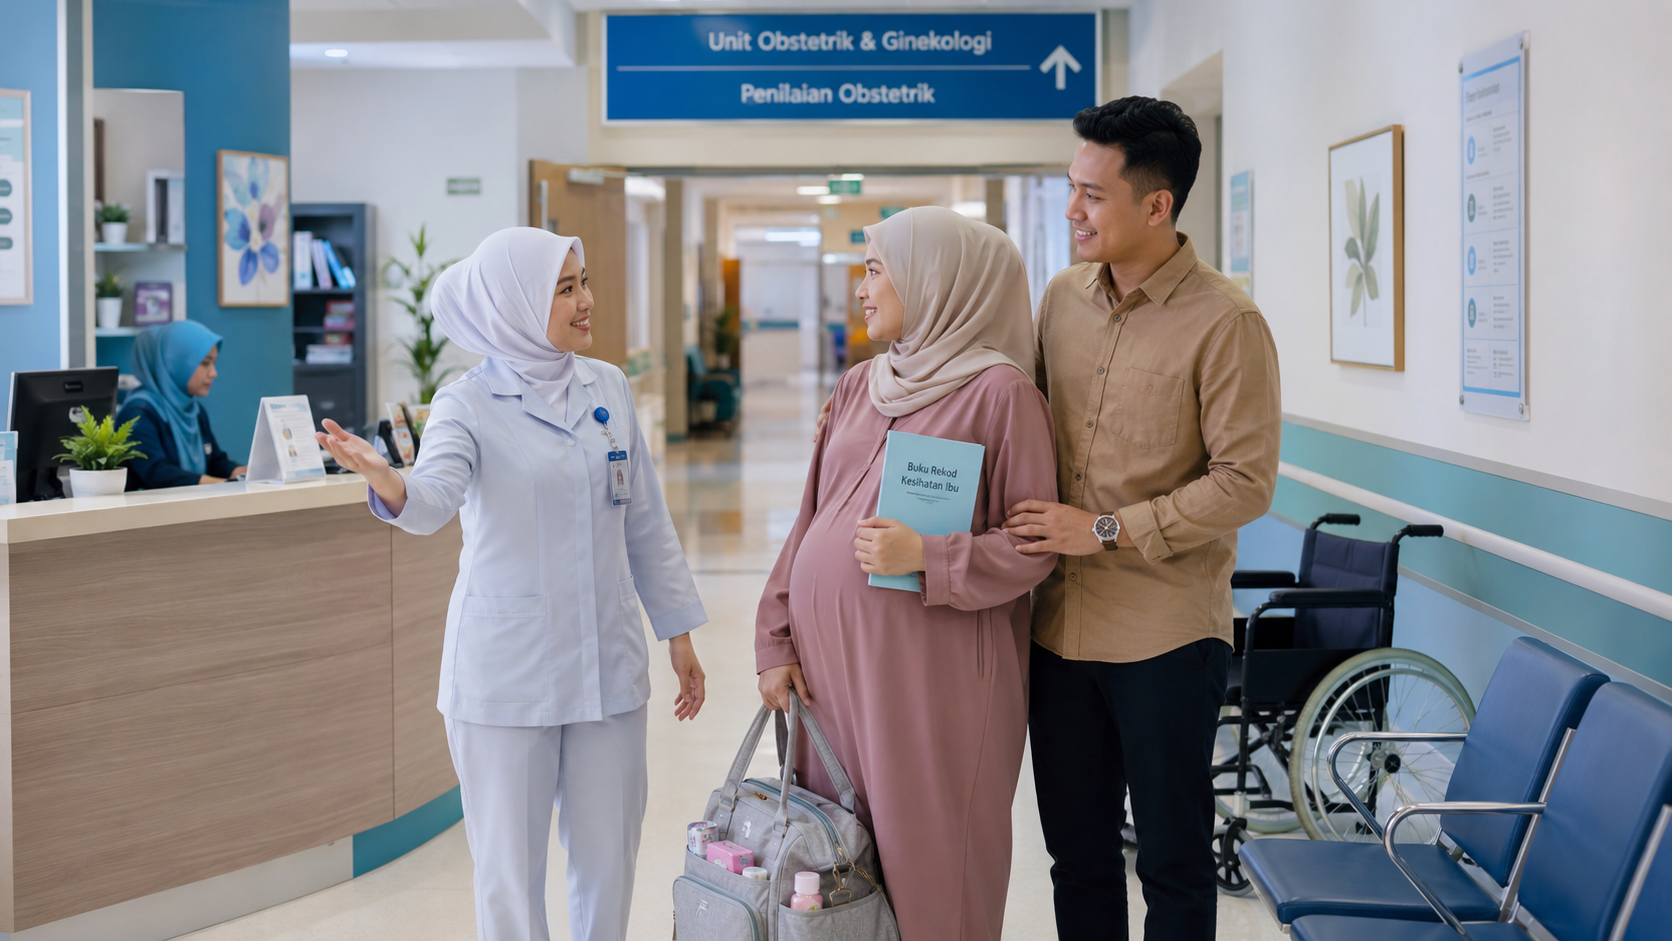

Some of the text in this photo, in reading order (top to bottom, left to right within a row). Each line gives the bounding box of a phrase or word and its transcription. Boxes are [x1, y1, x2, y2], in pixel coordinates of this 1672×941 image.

[708, 31, 992, 55] Unit Obstetrik & Ginekologi
[740, 83, 935, 104] Penilaian Obstetrik
[907, 461, 958, 478] Buku Rekod
[901, 475, 959, 493] Kesihatan Ibu
